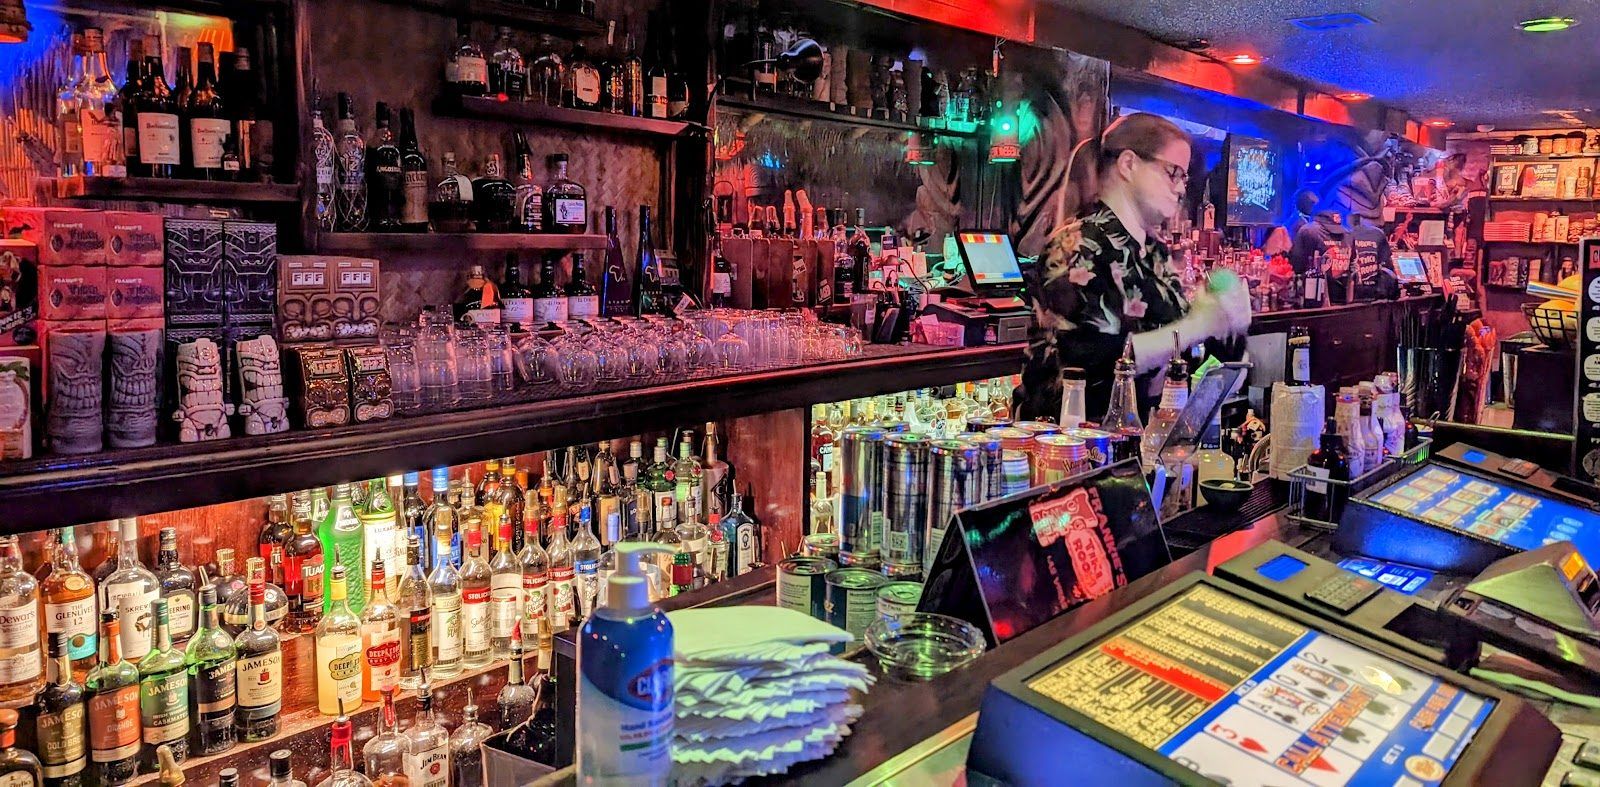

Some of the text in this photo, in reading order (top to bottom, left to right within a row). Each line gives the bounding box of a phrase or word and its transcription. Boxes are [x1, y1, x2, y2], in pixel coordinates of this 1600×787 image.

[1088, 486, 1128, 587] FRANKIE'S
[1072, 537, 1097, 588] ROOM
[1088, 538, 1103, 580] TIKI
[56, 606, 93, 620] GLENLIVET
[74, 617, 83, 625] 12
[1210, 724, 1238, 740] 3
[1275, 741, 1323, 775] CALL
[1307, 684, 1377, 747] ATTENDANT
